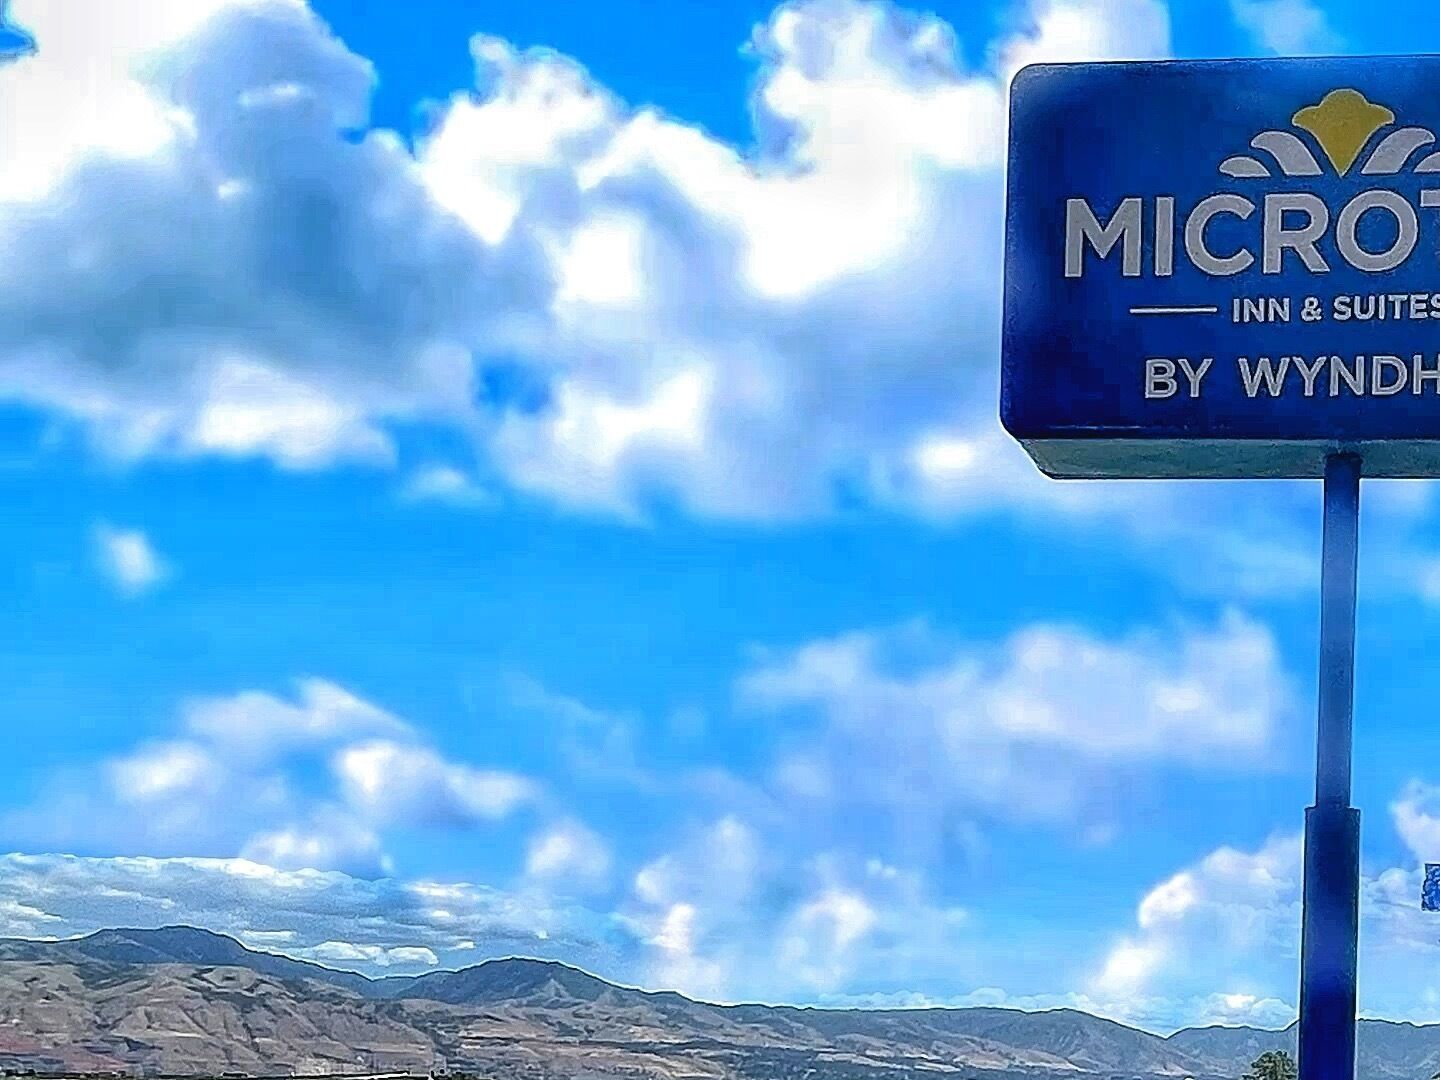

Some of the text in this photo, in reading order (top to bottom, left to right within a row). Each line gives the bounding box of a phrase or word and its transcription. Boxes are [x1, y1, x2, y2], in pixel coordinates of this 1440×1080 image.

[1233, 297, 1290, 323] INN
[1301, 296, 1322, 322] &
[1144, 358, 1212, 399] BY
